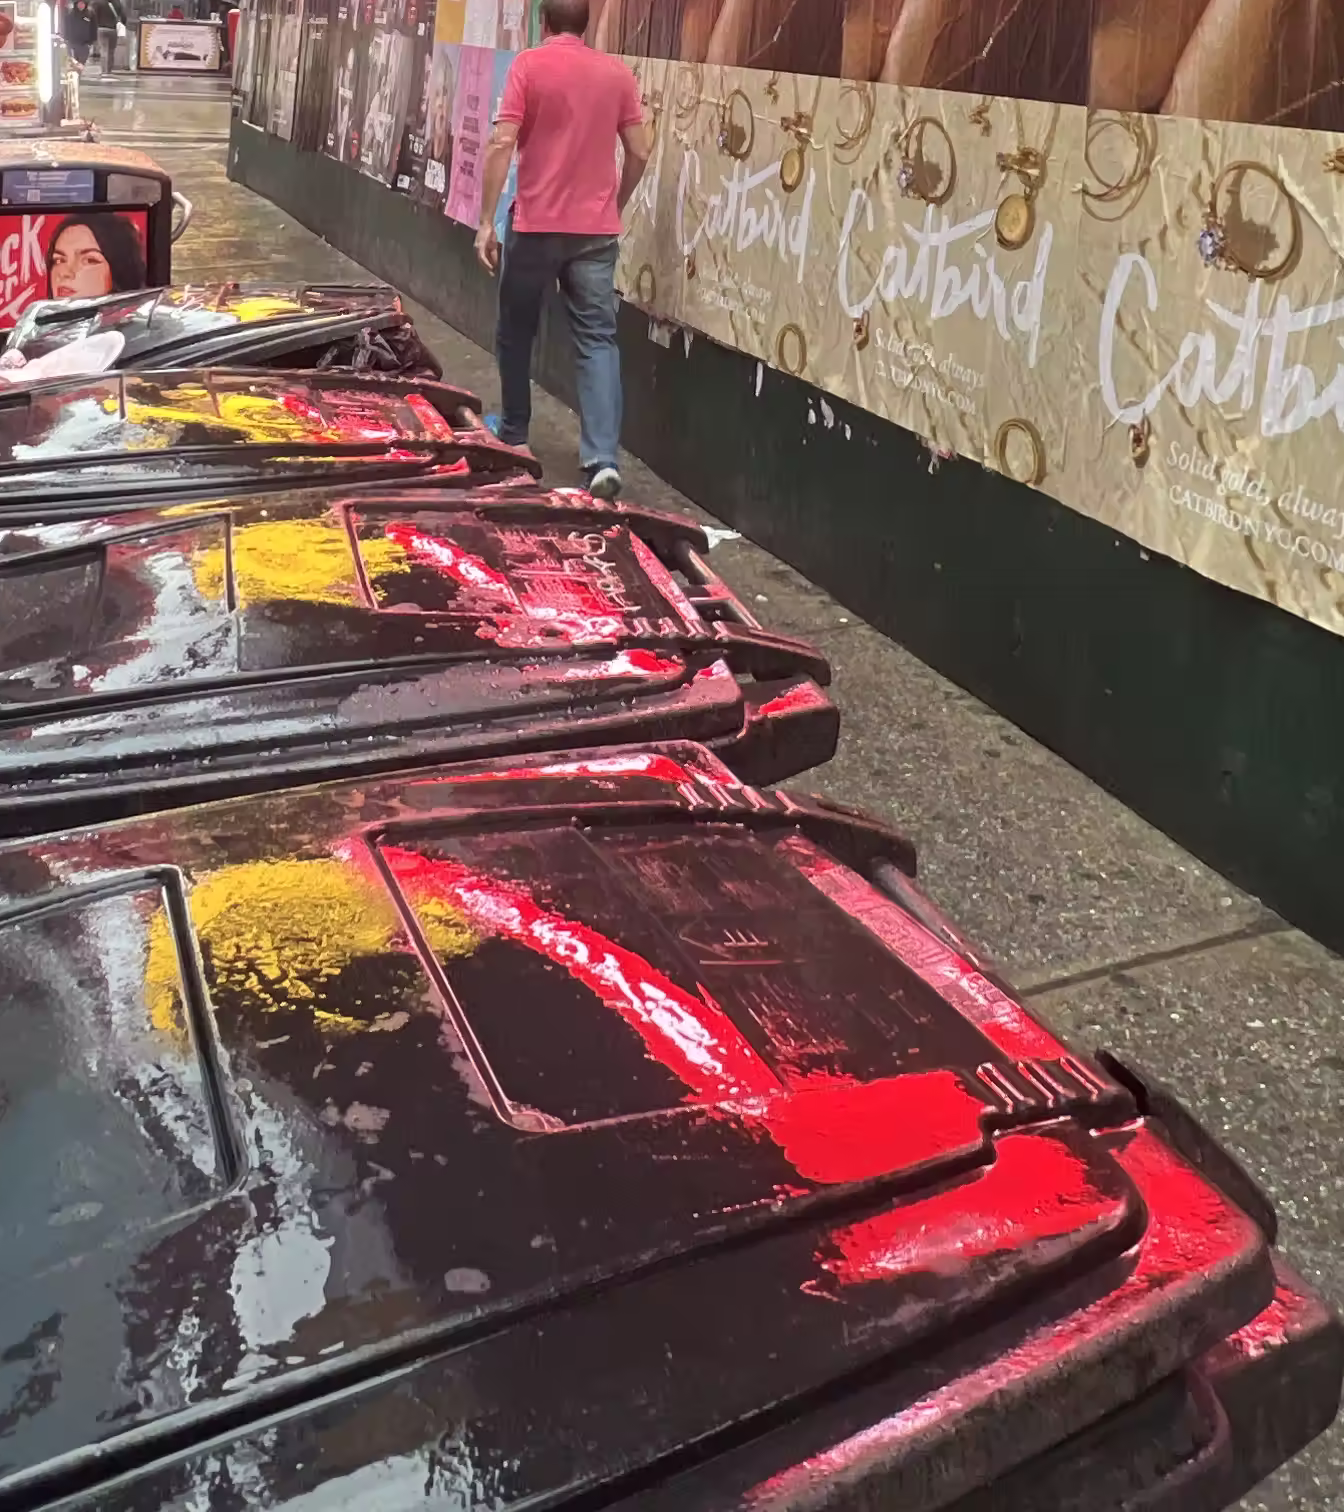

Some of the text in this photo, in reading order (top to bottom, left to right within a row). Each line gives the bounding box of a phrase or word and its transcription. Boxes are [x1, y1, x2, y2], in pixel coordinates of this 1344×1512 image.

[675, 148, 816, 284] Catbird
[837, 188, 1053, 368] Catbird
[1166, 440, 1218, 481] Solid
[1216, 461, 1272, 507] gold,
